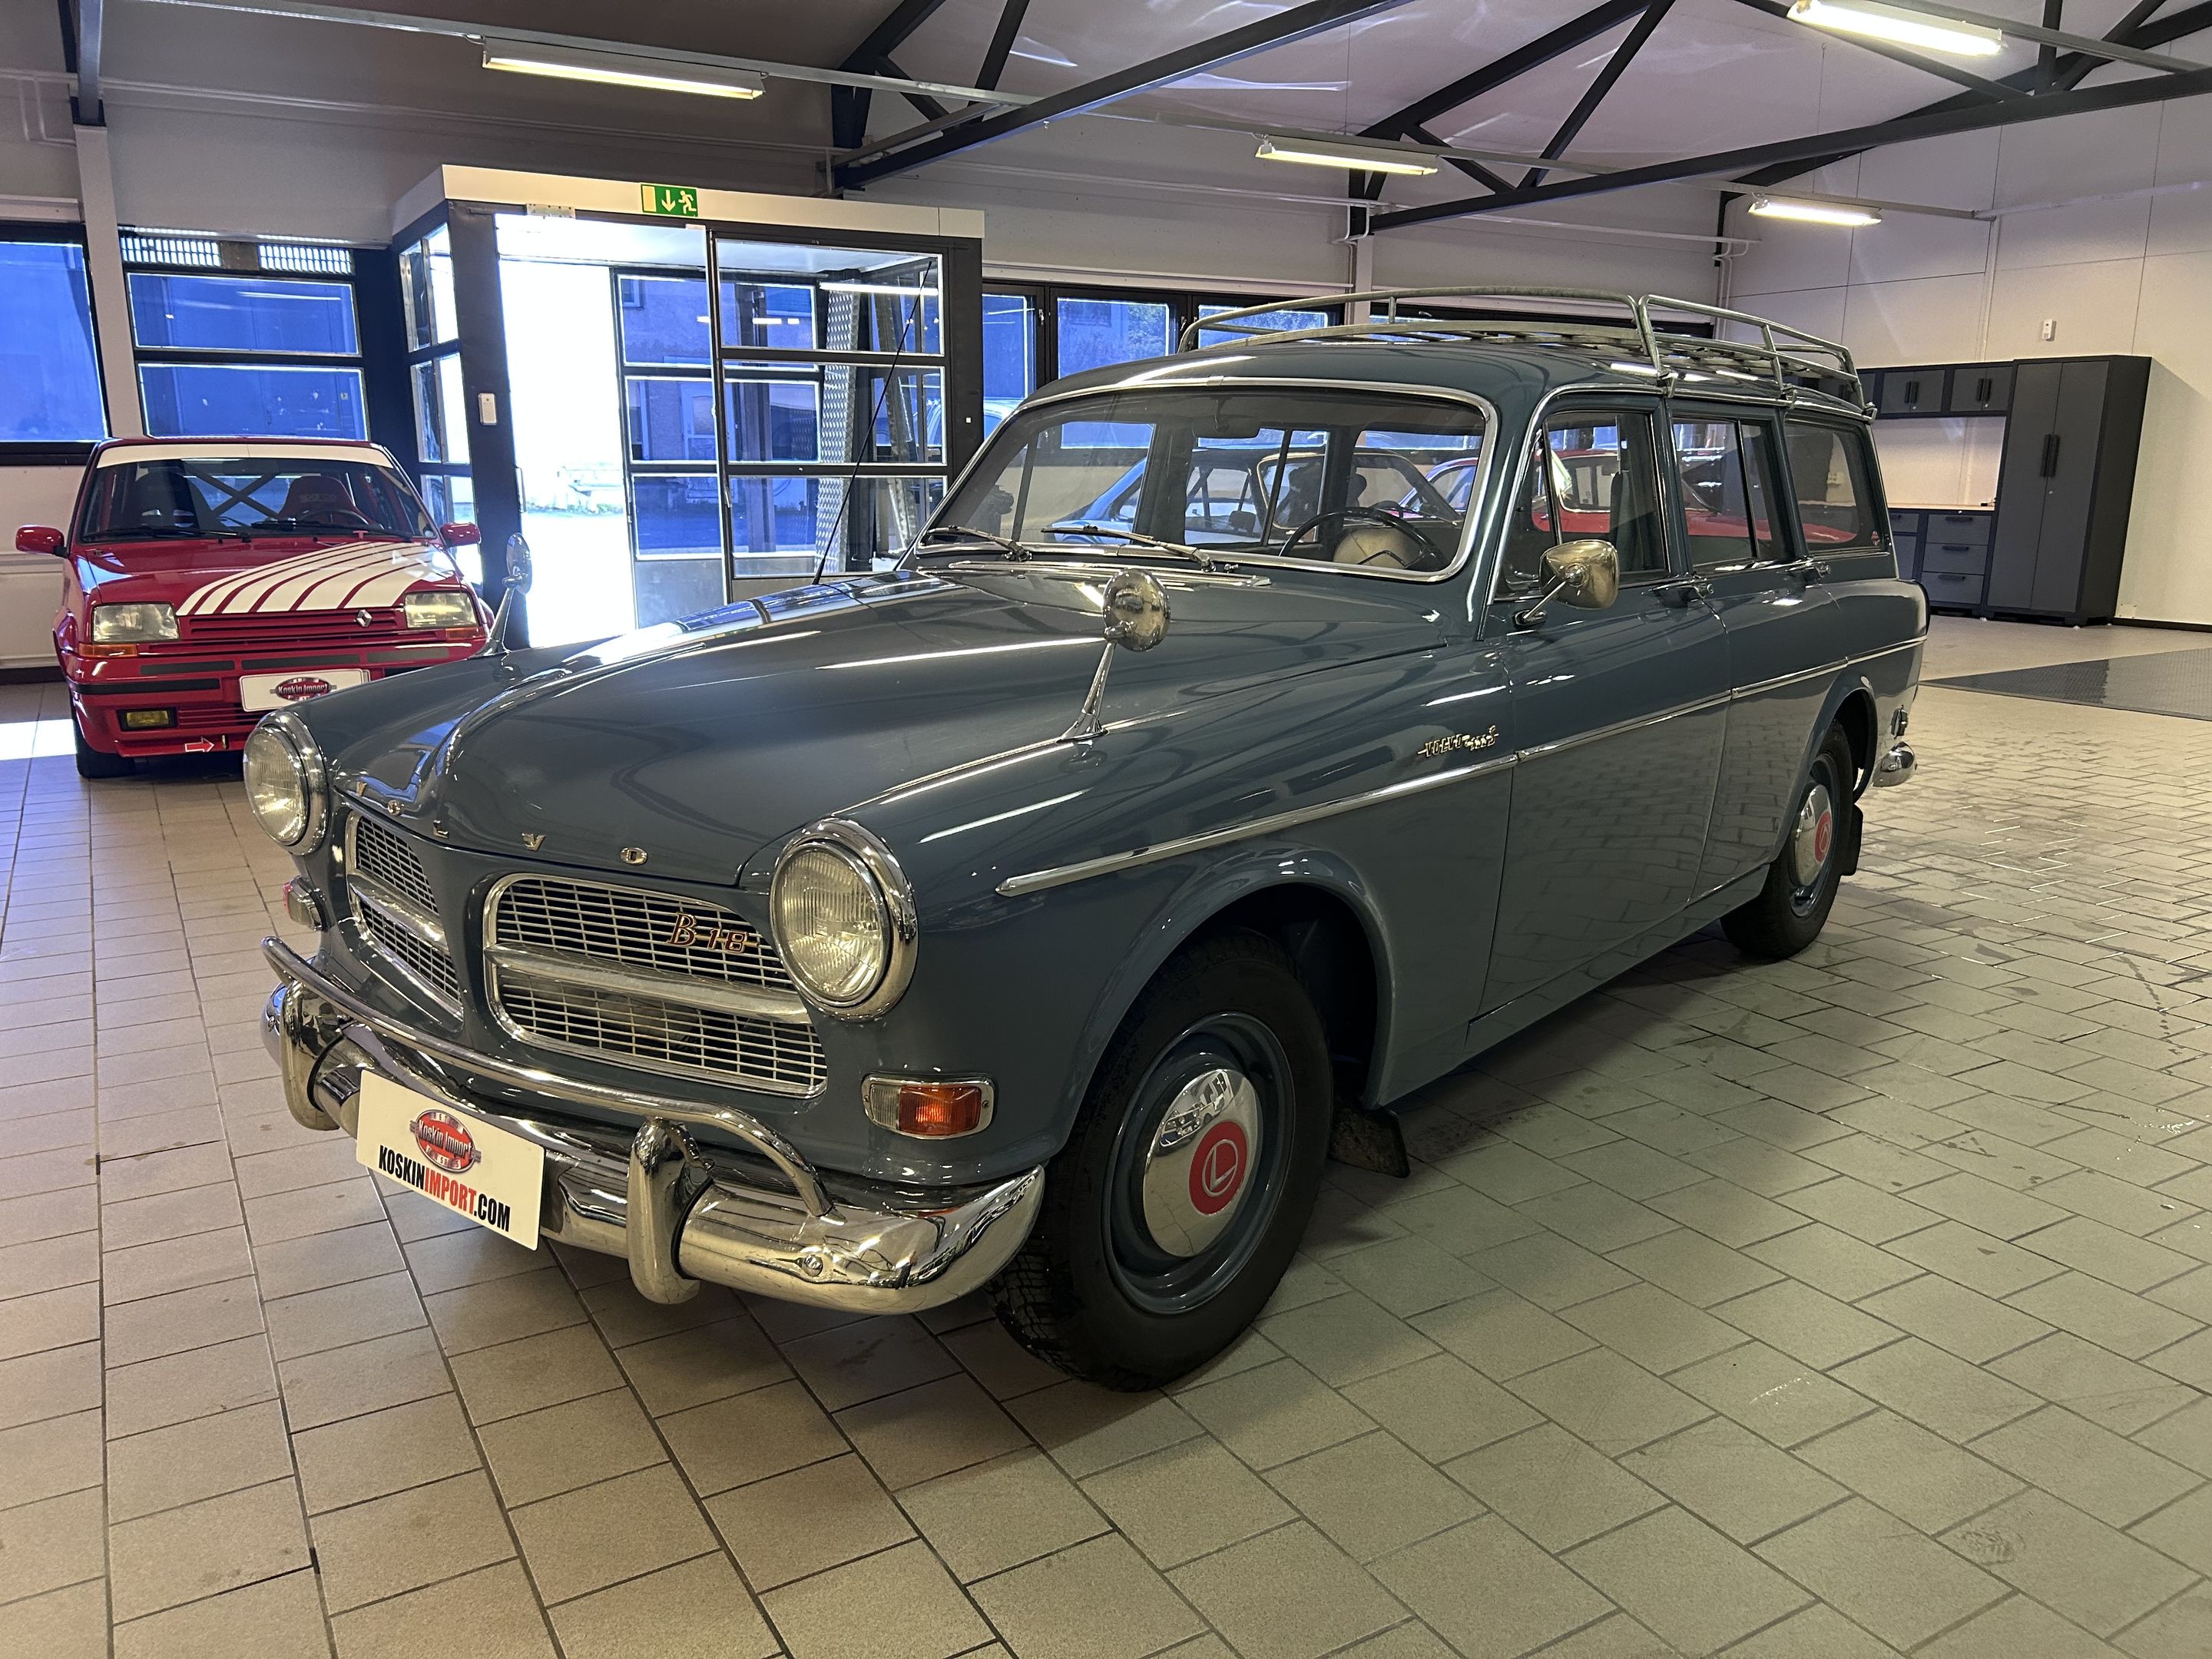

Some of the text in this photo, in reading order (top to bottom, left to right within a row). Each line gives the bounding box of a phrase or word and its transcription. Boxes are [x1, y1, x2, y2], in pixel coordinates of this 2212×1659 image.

[1425, 733, 1462, 757] VOLVO
[418, 1119, 472, 1158] Koskin Import
[379, 1144, 511, 1232] KOSKINIMPORT.COM
